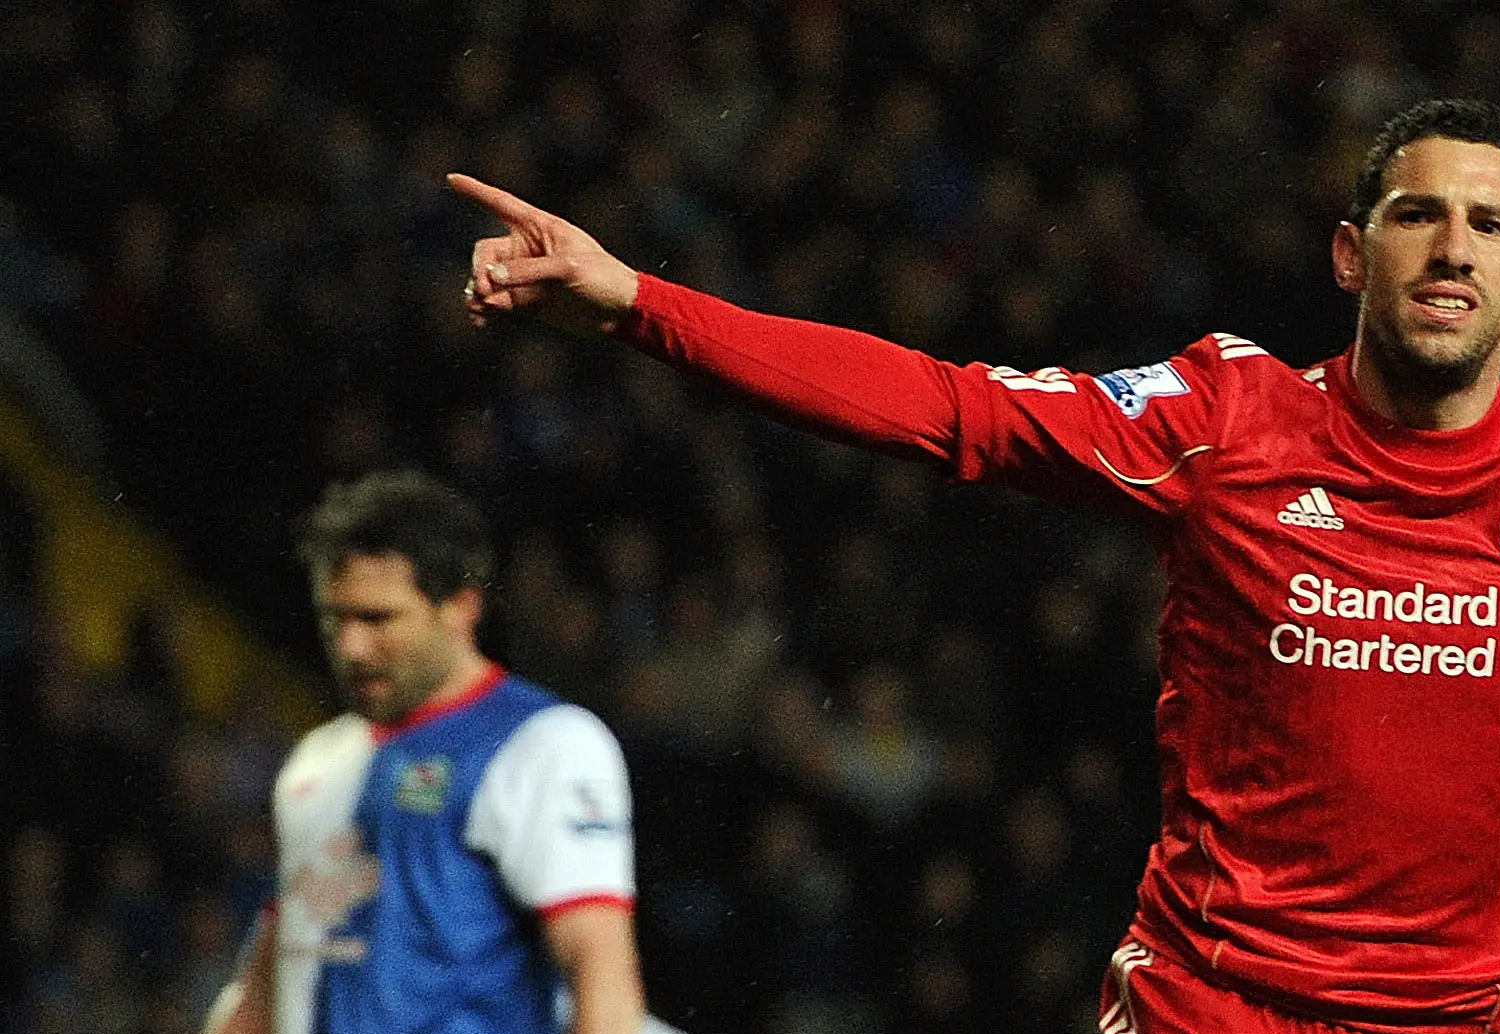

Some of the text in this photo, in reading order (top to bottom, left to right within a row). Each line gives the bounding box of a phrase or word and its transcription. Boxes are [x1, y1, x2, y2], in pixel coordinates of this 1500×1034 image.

[1277, 511, 1345, 531] adidas
[1287, 573, 1498, 627] Standard
[1269, 622, 1496, 678] Chartered
